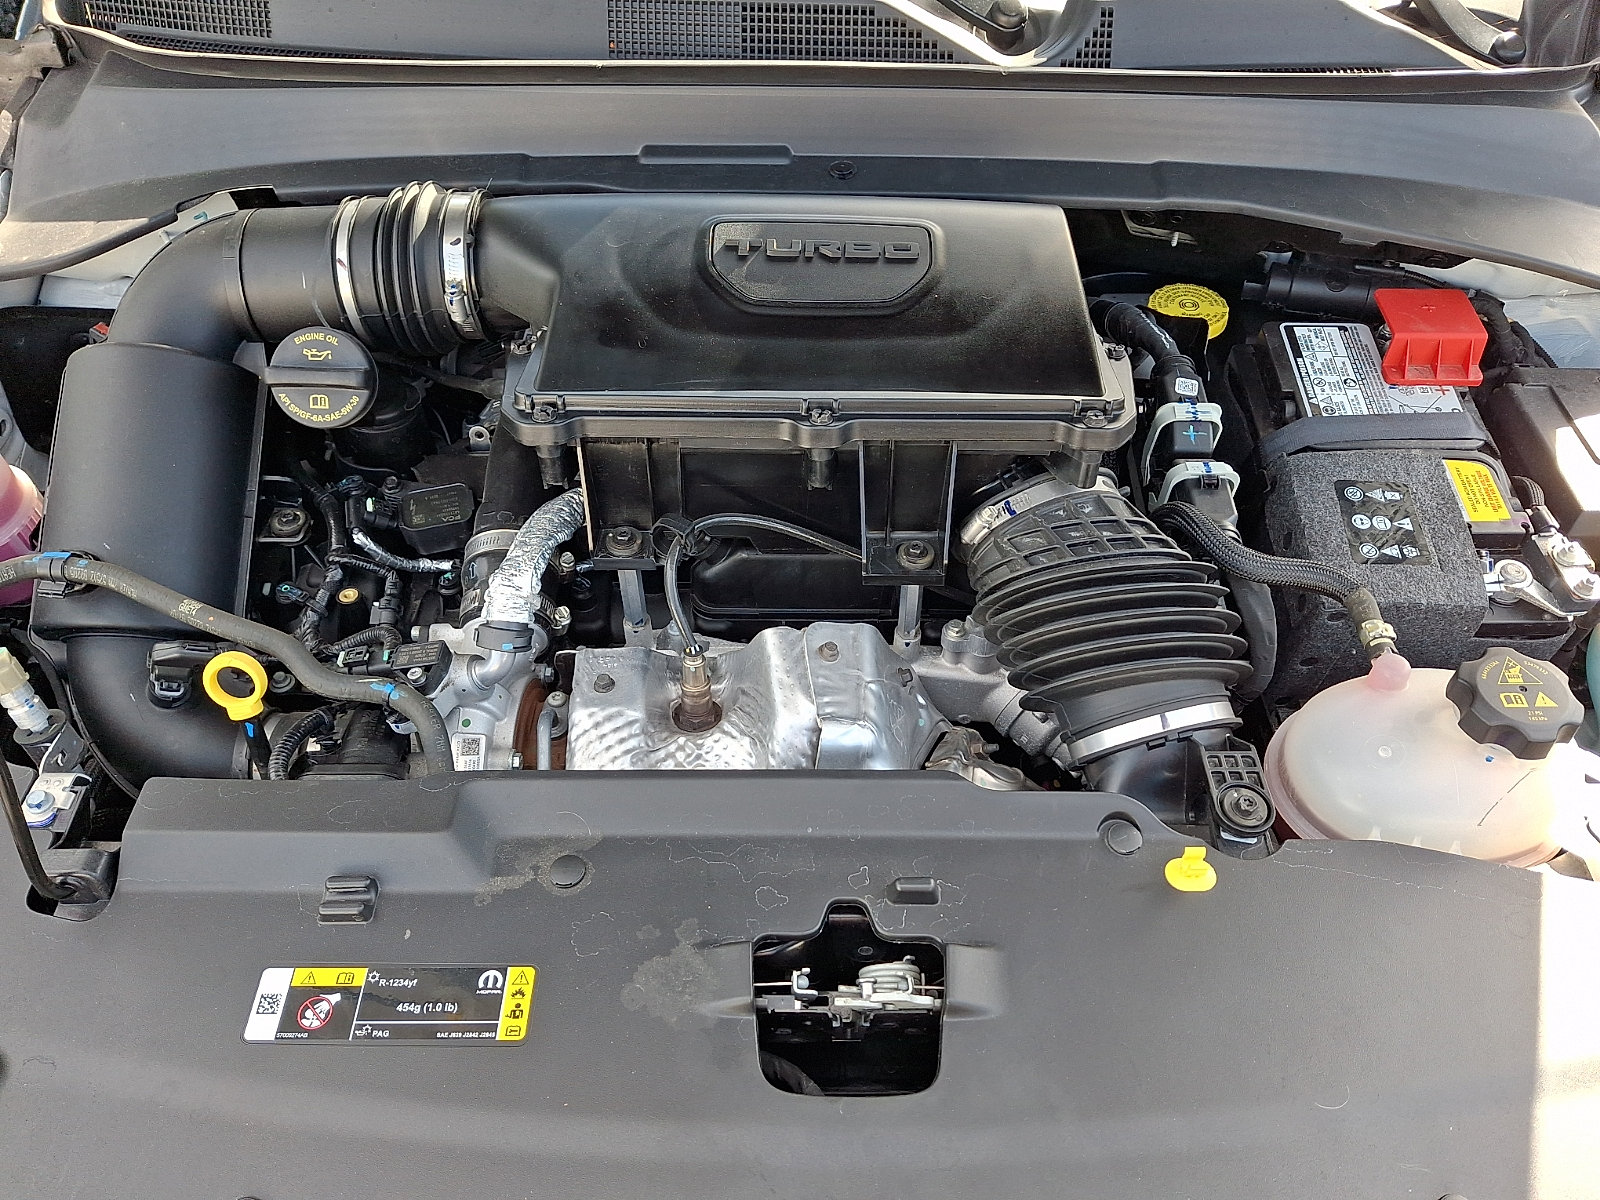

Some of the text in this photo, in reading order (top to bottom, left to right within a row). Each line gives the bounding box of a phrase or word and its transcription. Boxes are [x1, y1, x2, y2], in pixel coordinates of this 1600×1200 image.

[725, 238, 920, 260] TURBO
[293, 332, 339, 346] ENGINE OIL
[278, 393, 290, 407] API
[378, 978, 418, 988] R-1234yf
[396, 1002, 458, 1015] 454g (1.0 lb)
[371, 1030, 390, 1038] PAG
